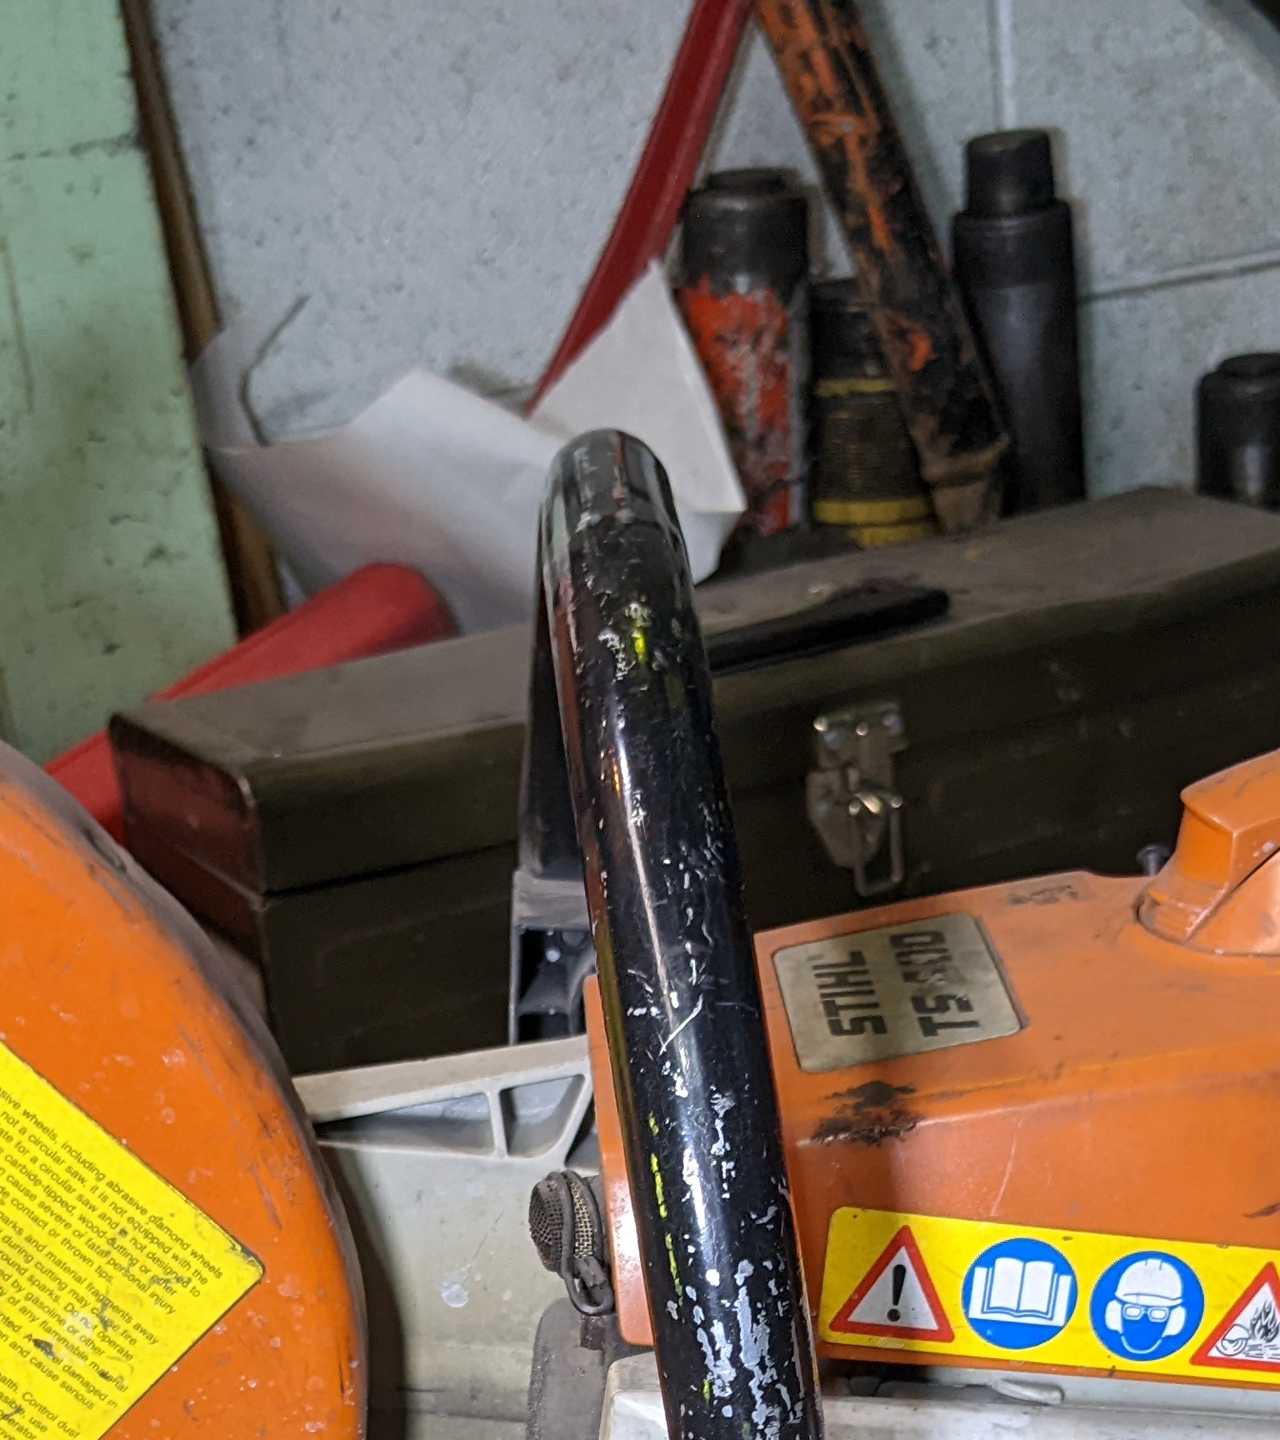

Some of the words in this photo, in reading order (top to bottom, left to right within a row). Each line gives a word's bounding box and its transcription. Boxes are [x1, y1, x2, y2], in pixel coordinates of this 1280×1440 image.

[812, 951, 888, 1037] STIHL
[911, 994, 981, 1037] TS
[0, 1110, 20, 1128] not
[17, 1125, 27, 1136] a
[27, 1133, 65, 1166] circular
[64, 1165, 87, 1187] saw,
[88, 1183, 99, 1194] it
[97, 1190, 109, 1203] is
[108, 1200, 127, 1218] not
[126, 1216, 173, 1254] equipped
[170, 1252, 191, 1271] with
[191, 1268, 208, 1285] the
[60, 1140, 106, 1182] including
[105, 1179, 148, 1215] abrasive
[147, 1214, 191, 1251] diamond
[189, 1248, 223, 1279] wheels
